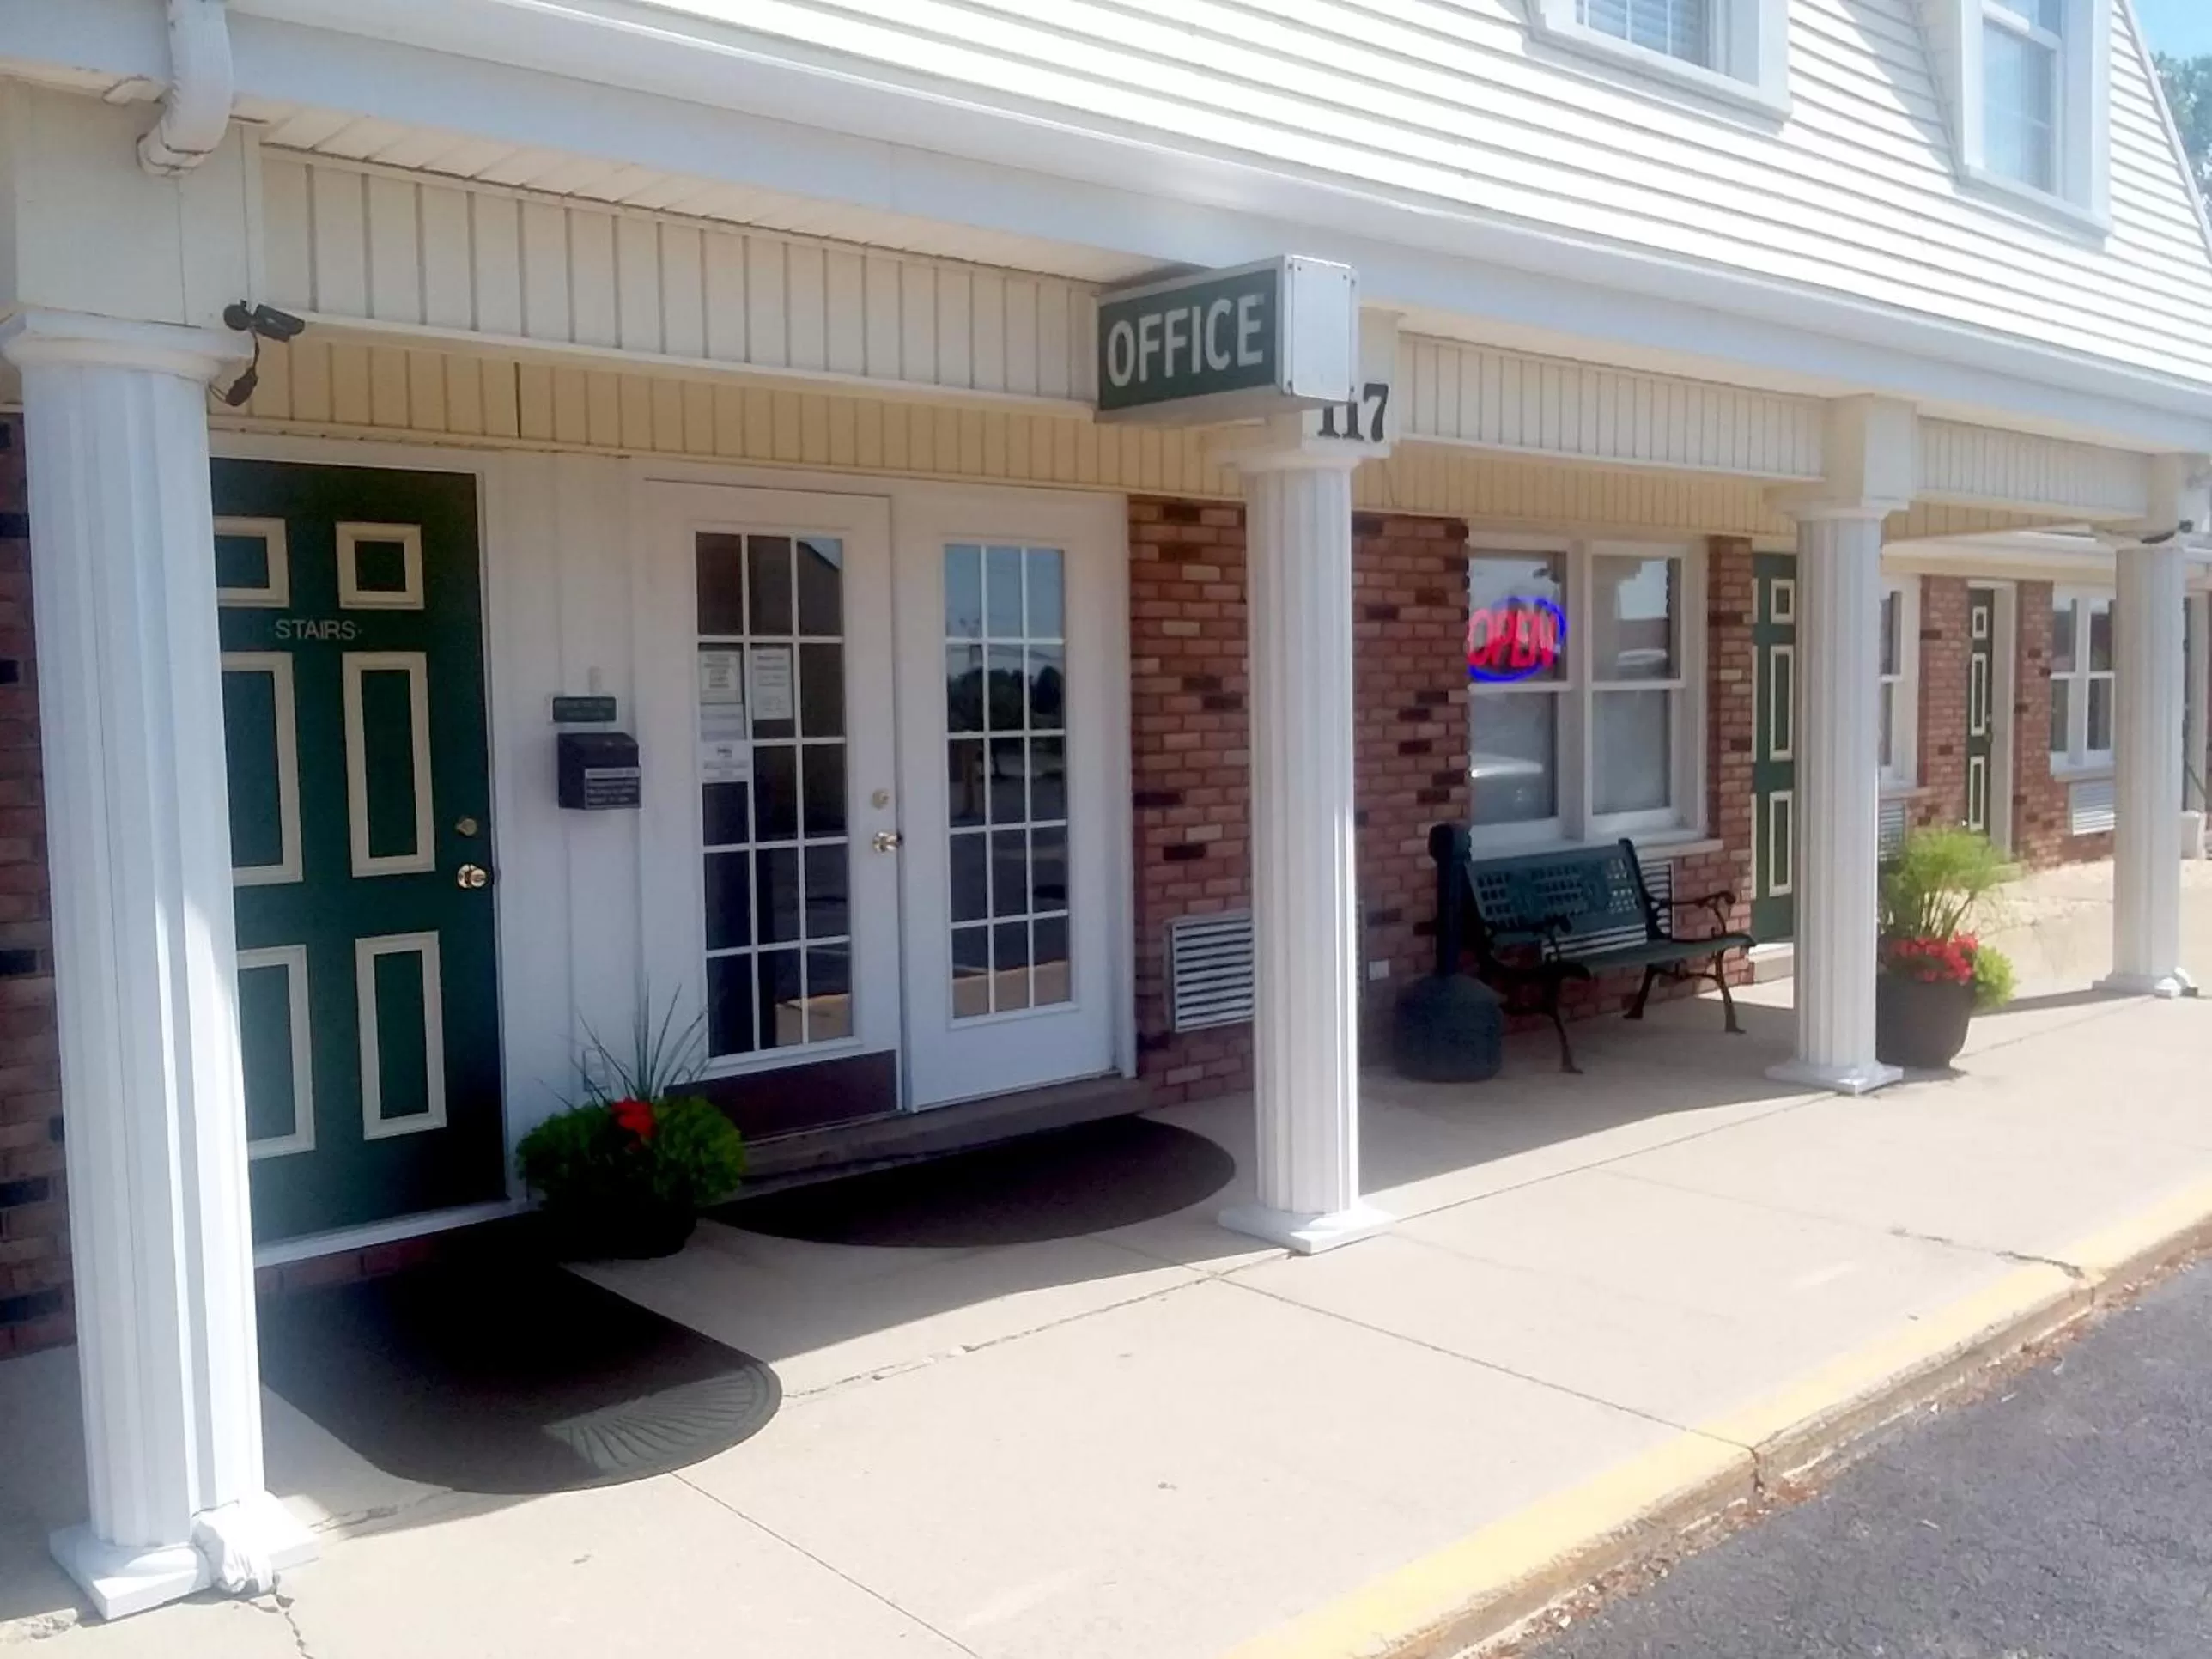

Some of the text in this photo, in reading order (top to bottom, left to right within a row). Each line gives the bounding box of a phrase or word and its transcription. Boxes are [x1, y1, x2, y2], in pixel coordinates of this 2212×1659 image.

[1107, 295, 1266, 387] OFFICE
[275, 618, 357, 640] STAIRS
[1467, 608, 1559, 667] OPEN
